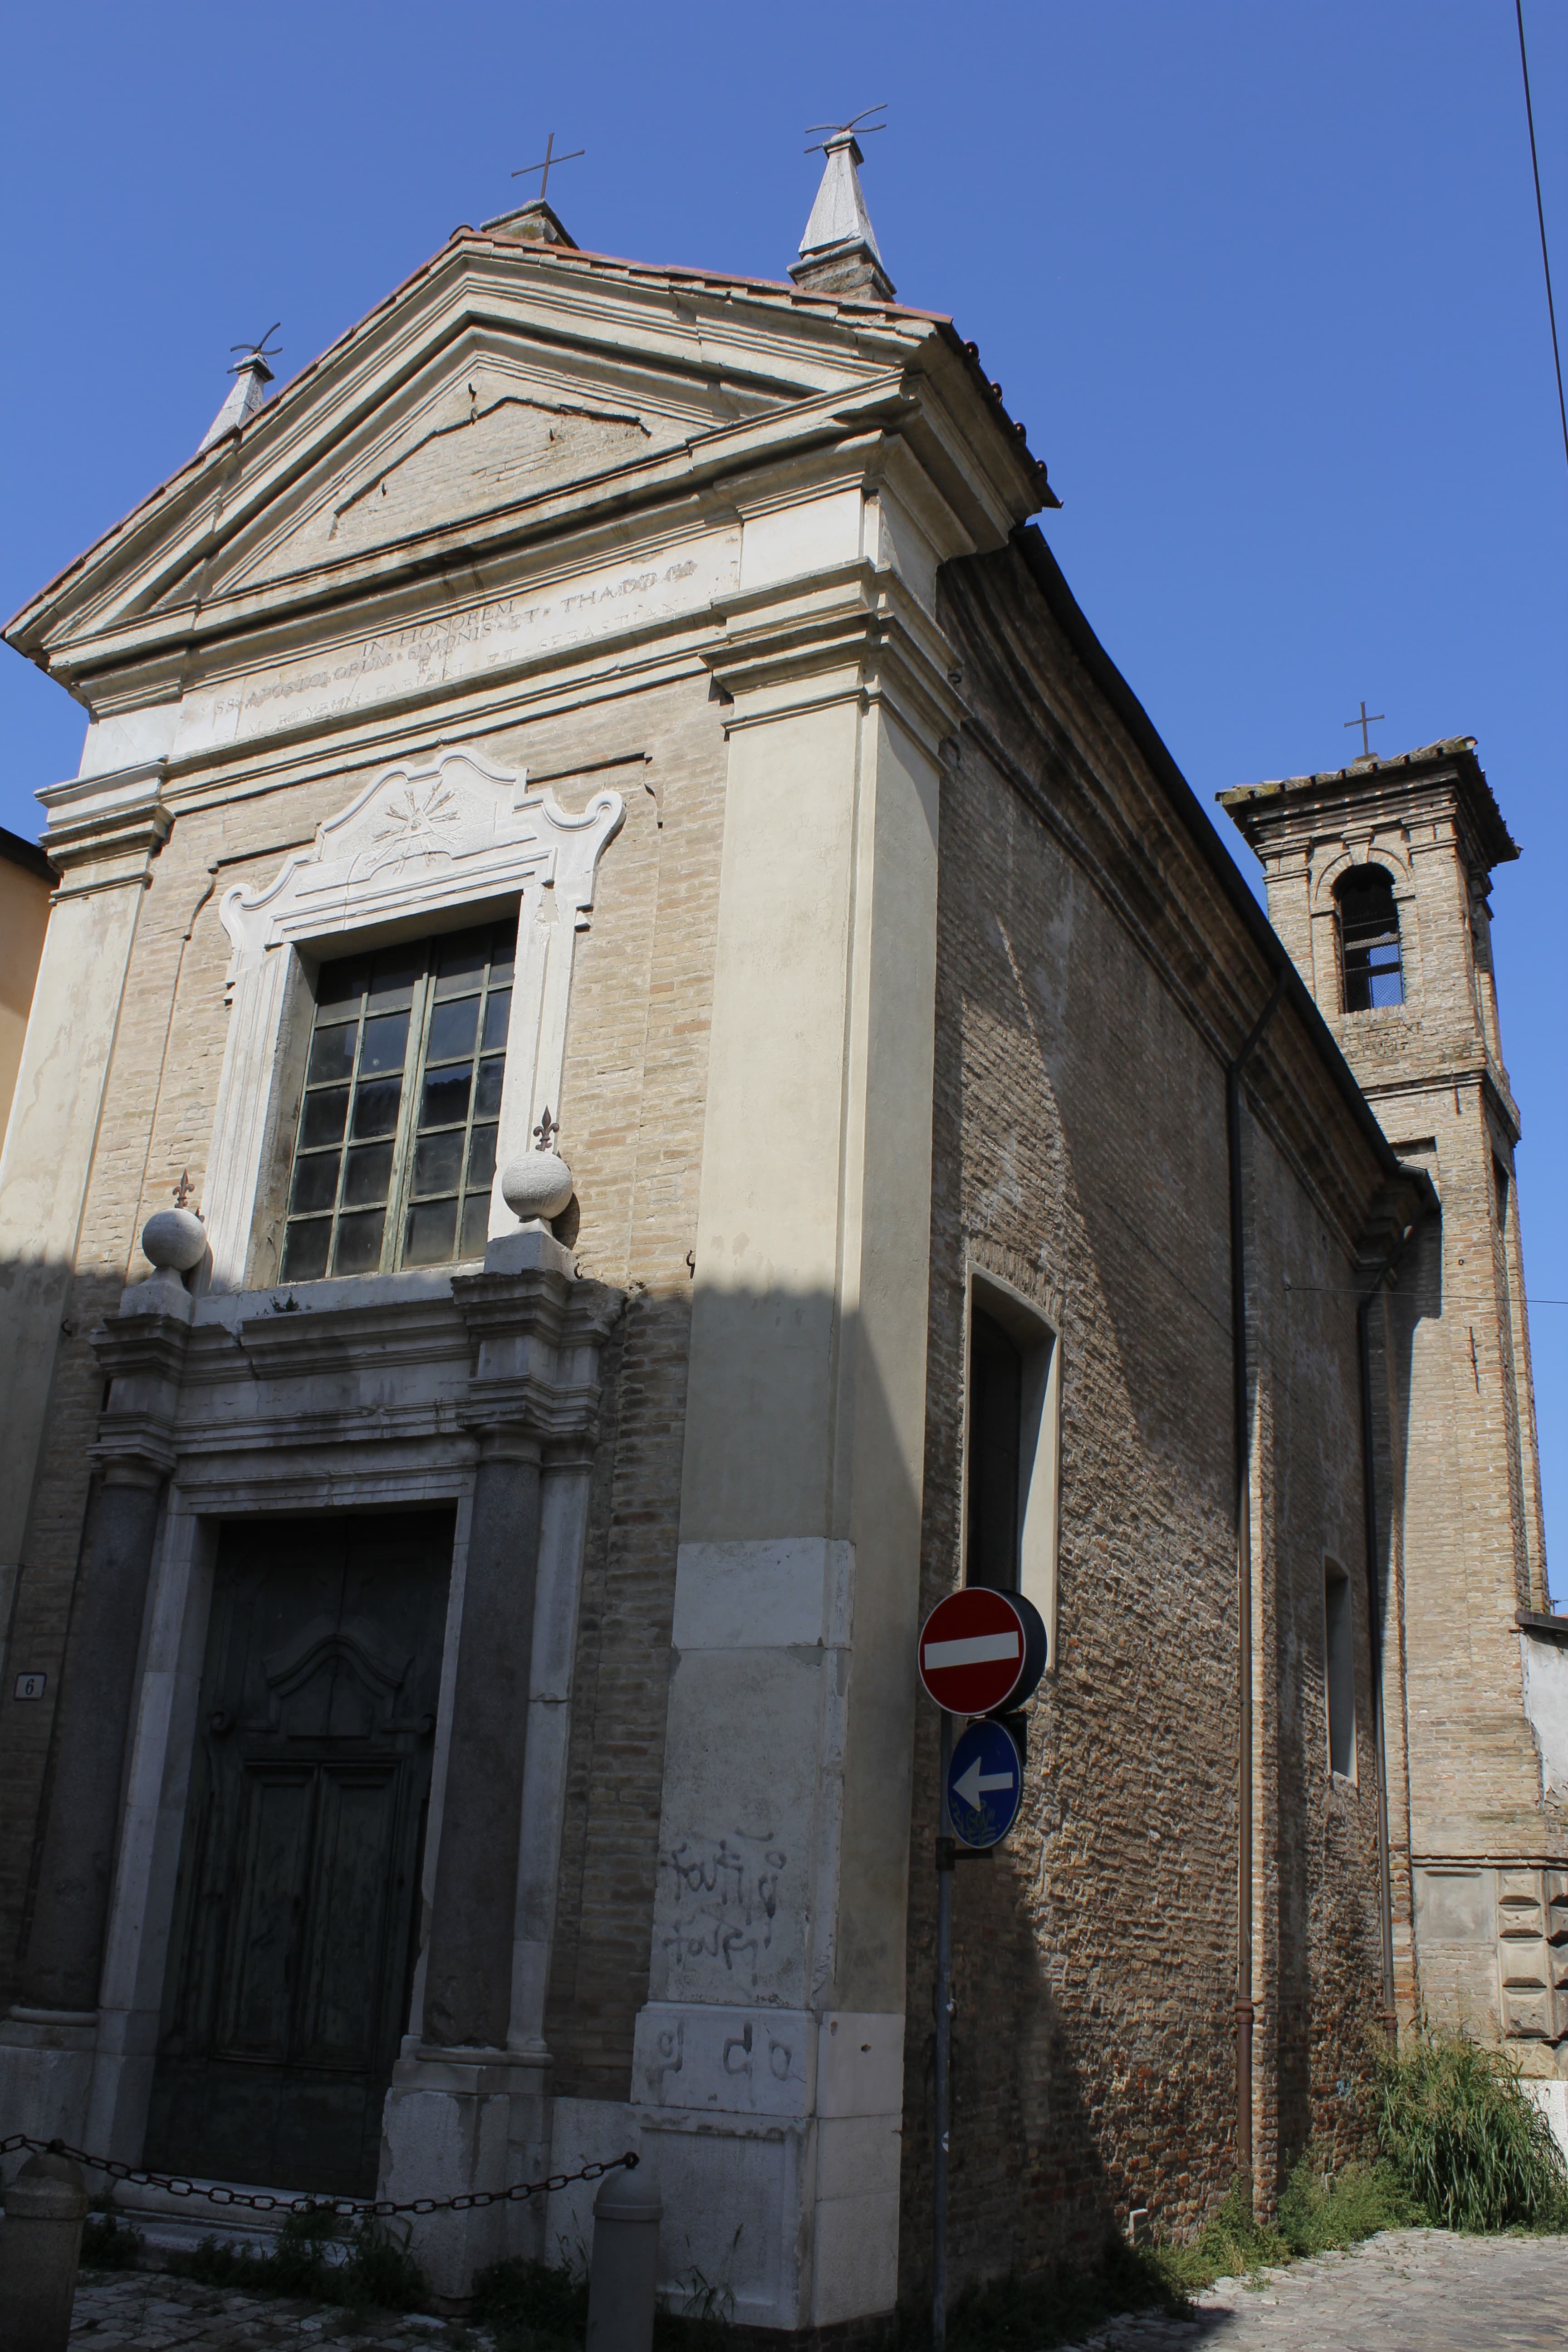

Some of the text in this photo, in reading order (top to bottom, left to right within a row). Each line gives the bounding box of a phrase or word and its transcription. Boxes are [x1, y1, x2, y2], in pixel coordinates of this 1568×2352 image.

[362, 600, 515, 657] IN HONOREM
[408, 622, 492, 660] SIMONIS
[510, 607, 540, 629] ET
[25, 1678, 34, 1695] 6
